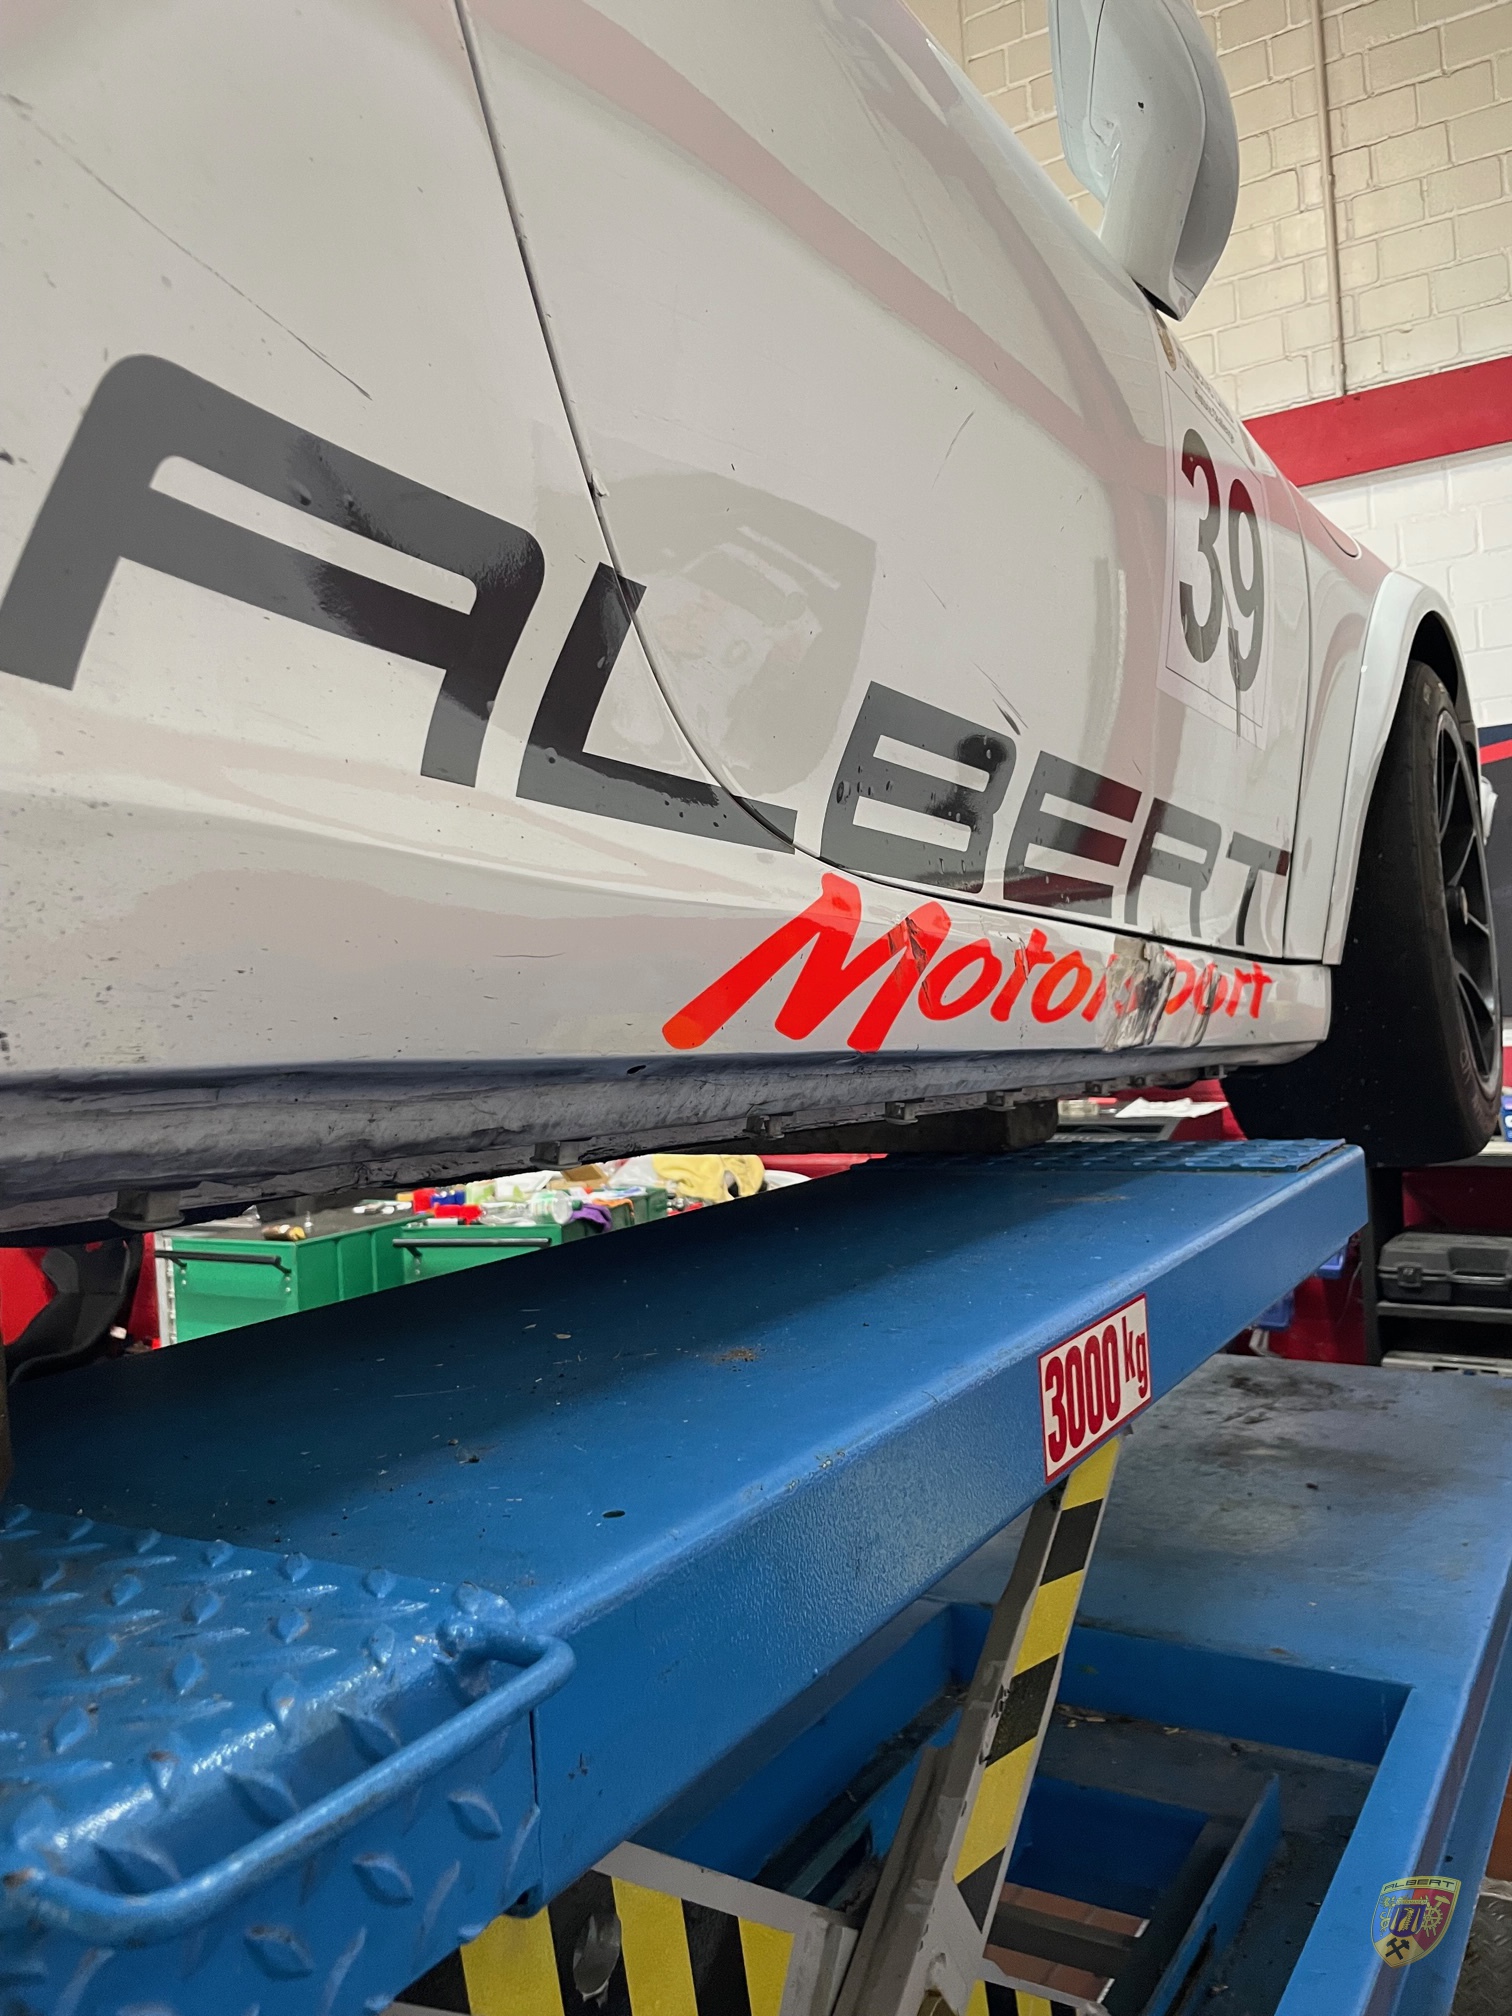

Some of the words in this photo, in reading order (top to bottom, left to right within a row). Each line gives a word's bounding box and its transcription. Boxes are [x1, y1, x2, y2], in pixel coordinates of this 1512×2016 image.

[0, 353, 1291, 947] ALBERT
[1178, 427, 1264, 692] 39
[1045, 1323, 1121, 1463] 3000
[1121, 1316, 1149, 1399] kg
